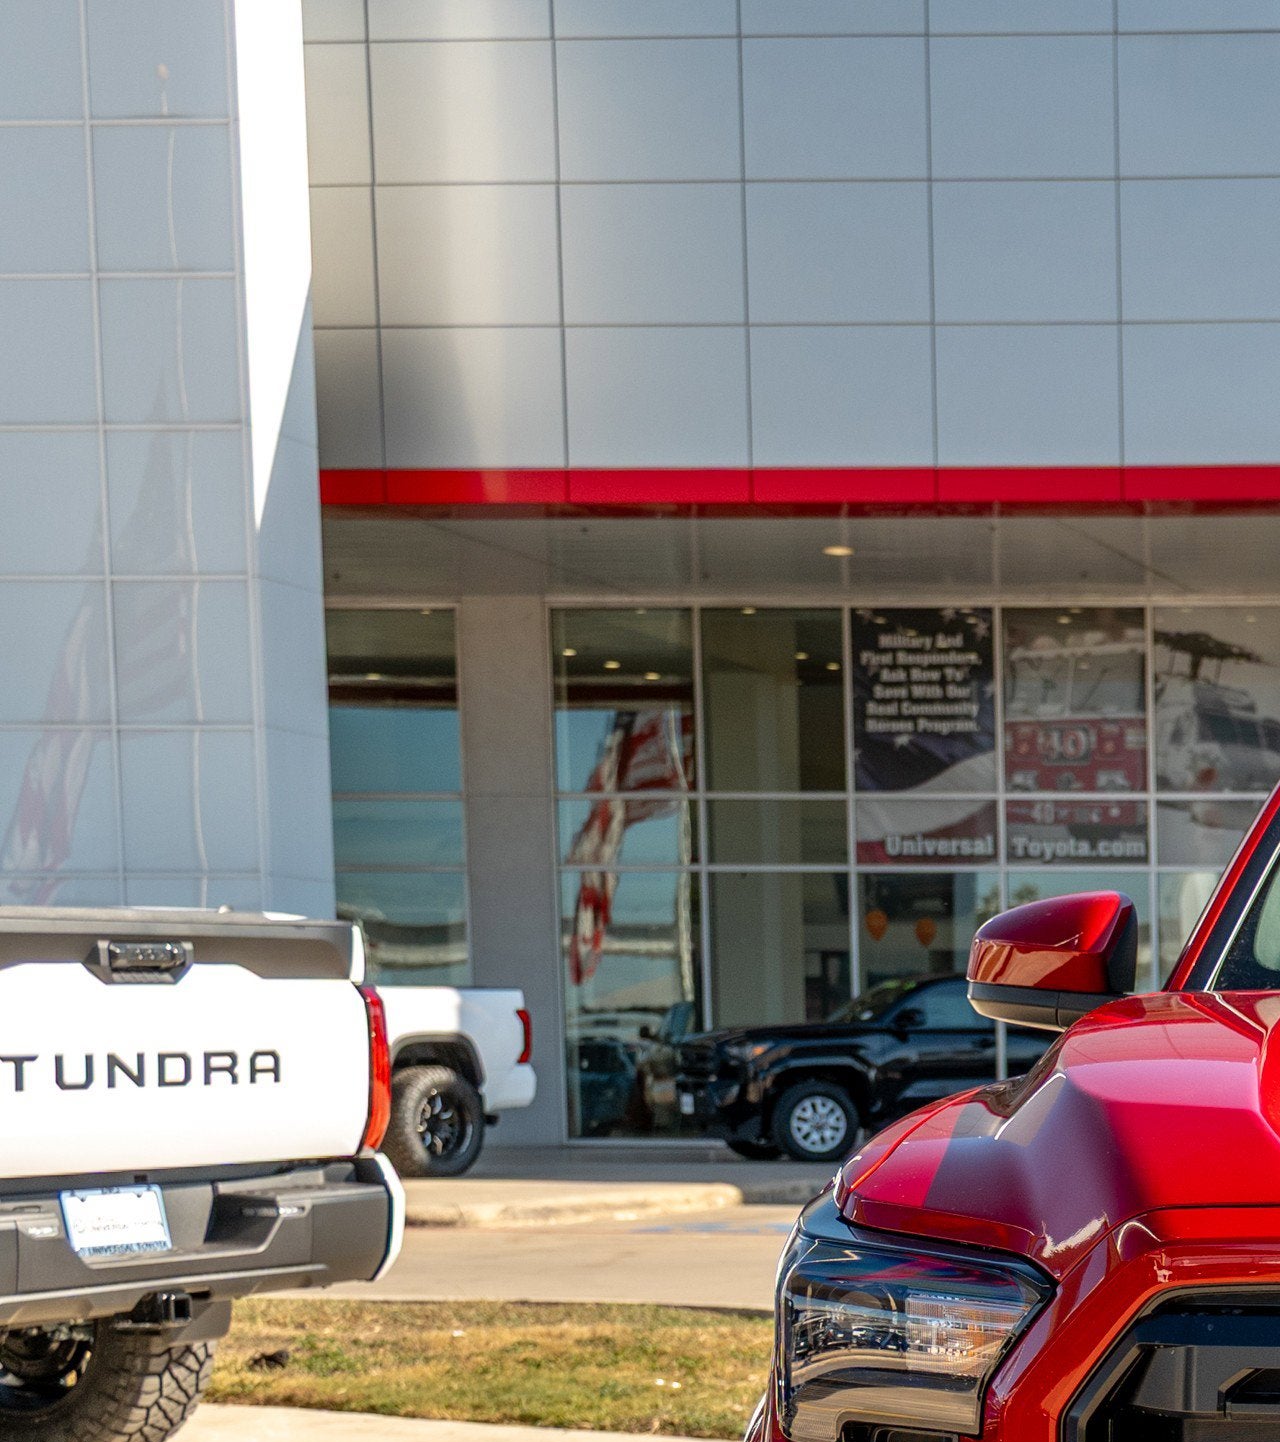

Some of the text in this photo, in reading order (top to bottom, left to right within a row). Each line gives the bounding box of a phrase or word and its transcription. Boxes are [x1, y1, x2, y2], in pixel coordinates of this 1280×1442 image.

[884, 834, 1146, 863] Universal Toyota.com
[0, 1050, 281, 1092] TUNDRA
